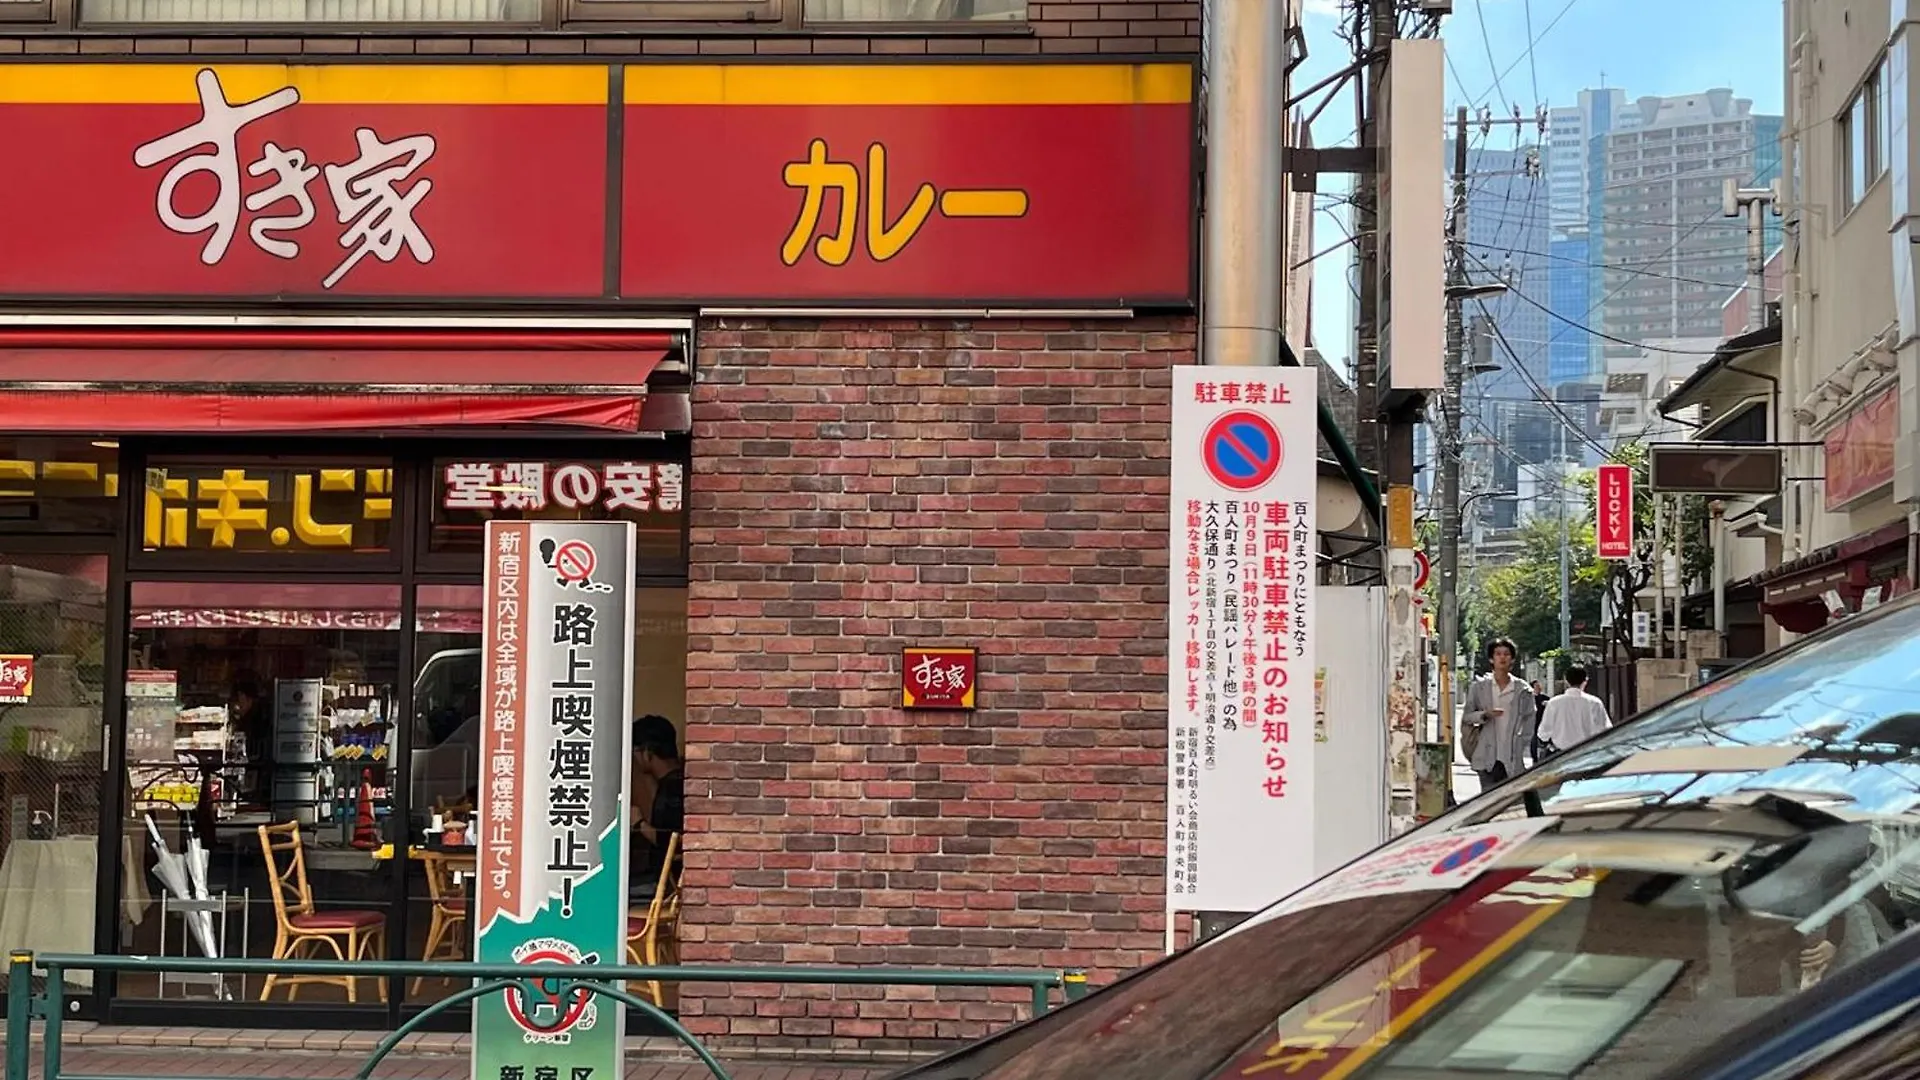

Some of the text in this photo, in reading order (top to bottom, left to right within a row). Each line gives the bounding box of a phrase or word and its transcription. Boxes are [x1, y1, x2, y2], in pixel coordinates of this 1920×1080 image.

[134, 68, 436, 289] すき家
[780, 138, 1030, 266] カレー
[1195, 381, 1291, 404] 駐車禁止
[1601, 542, 1629, 550] HOTEL
[1608, 473, 1622, 538] LUCKY
[1262, 501, 1290, 798] 車両駐車禁止のお知らせ
[1293, 501, 1309, 657] 百人町まつりにともなう
[489, 531, 522, 899] 新宿区内は全域が路上喫煙禁止です。
[911, 654, 966, 693] すき家
[547, 602, 598, 918] 路上喫煙禁止！
